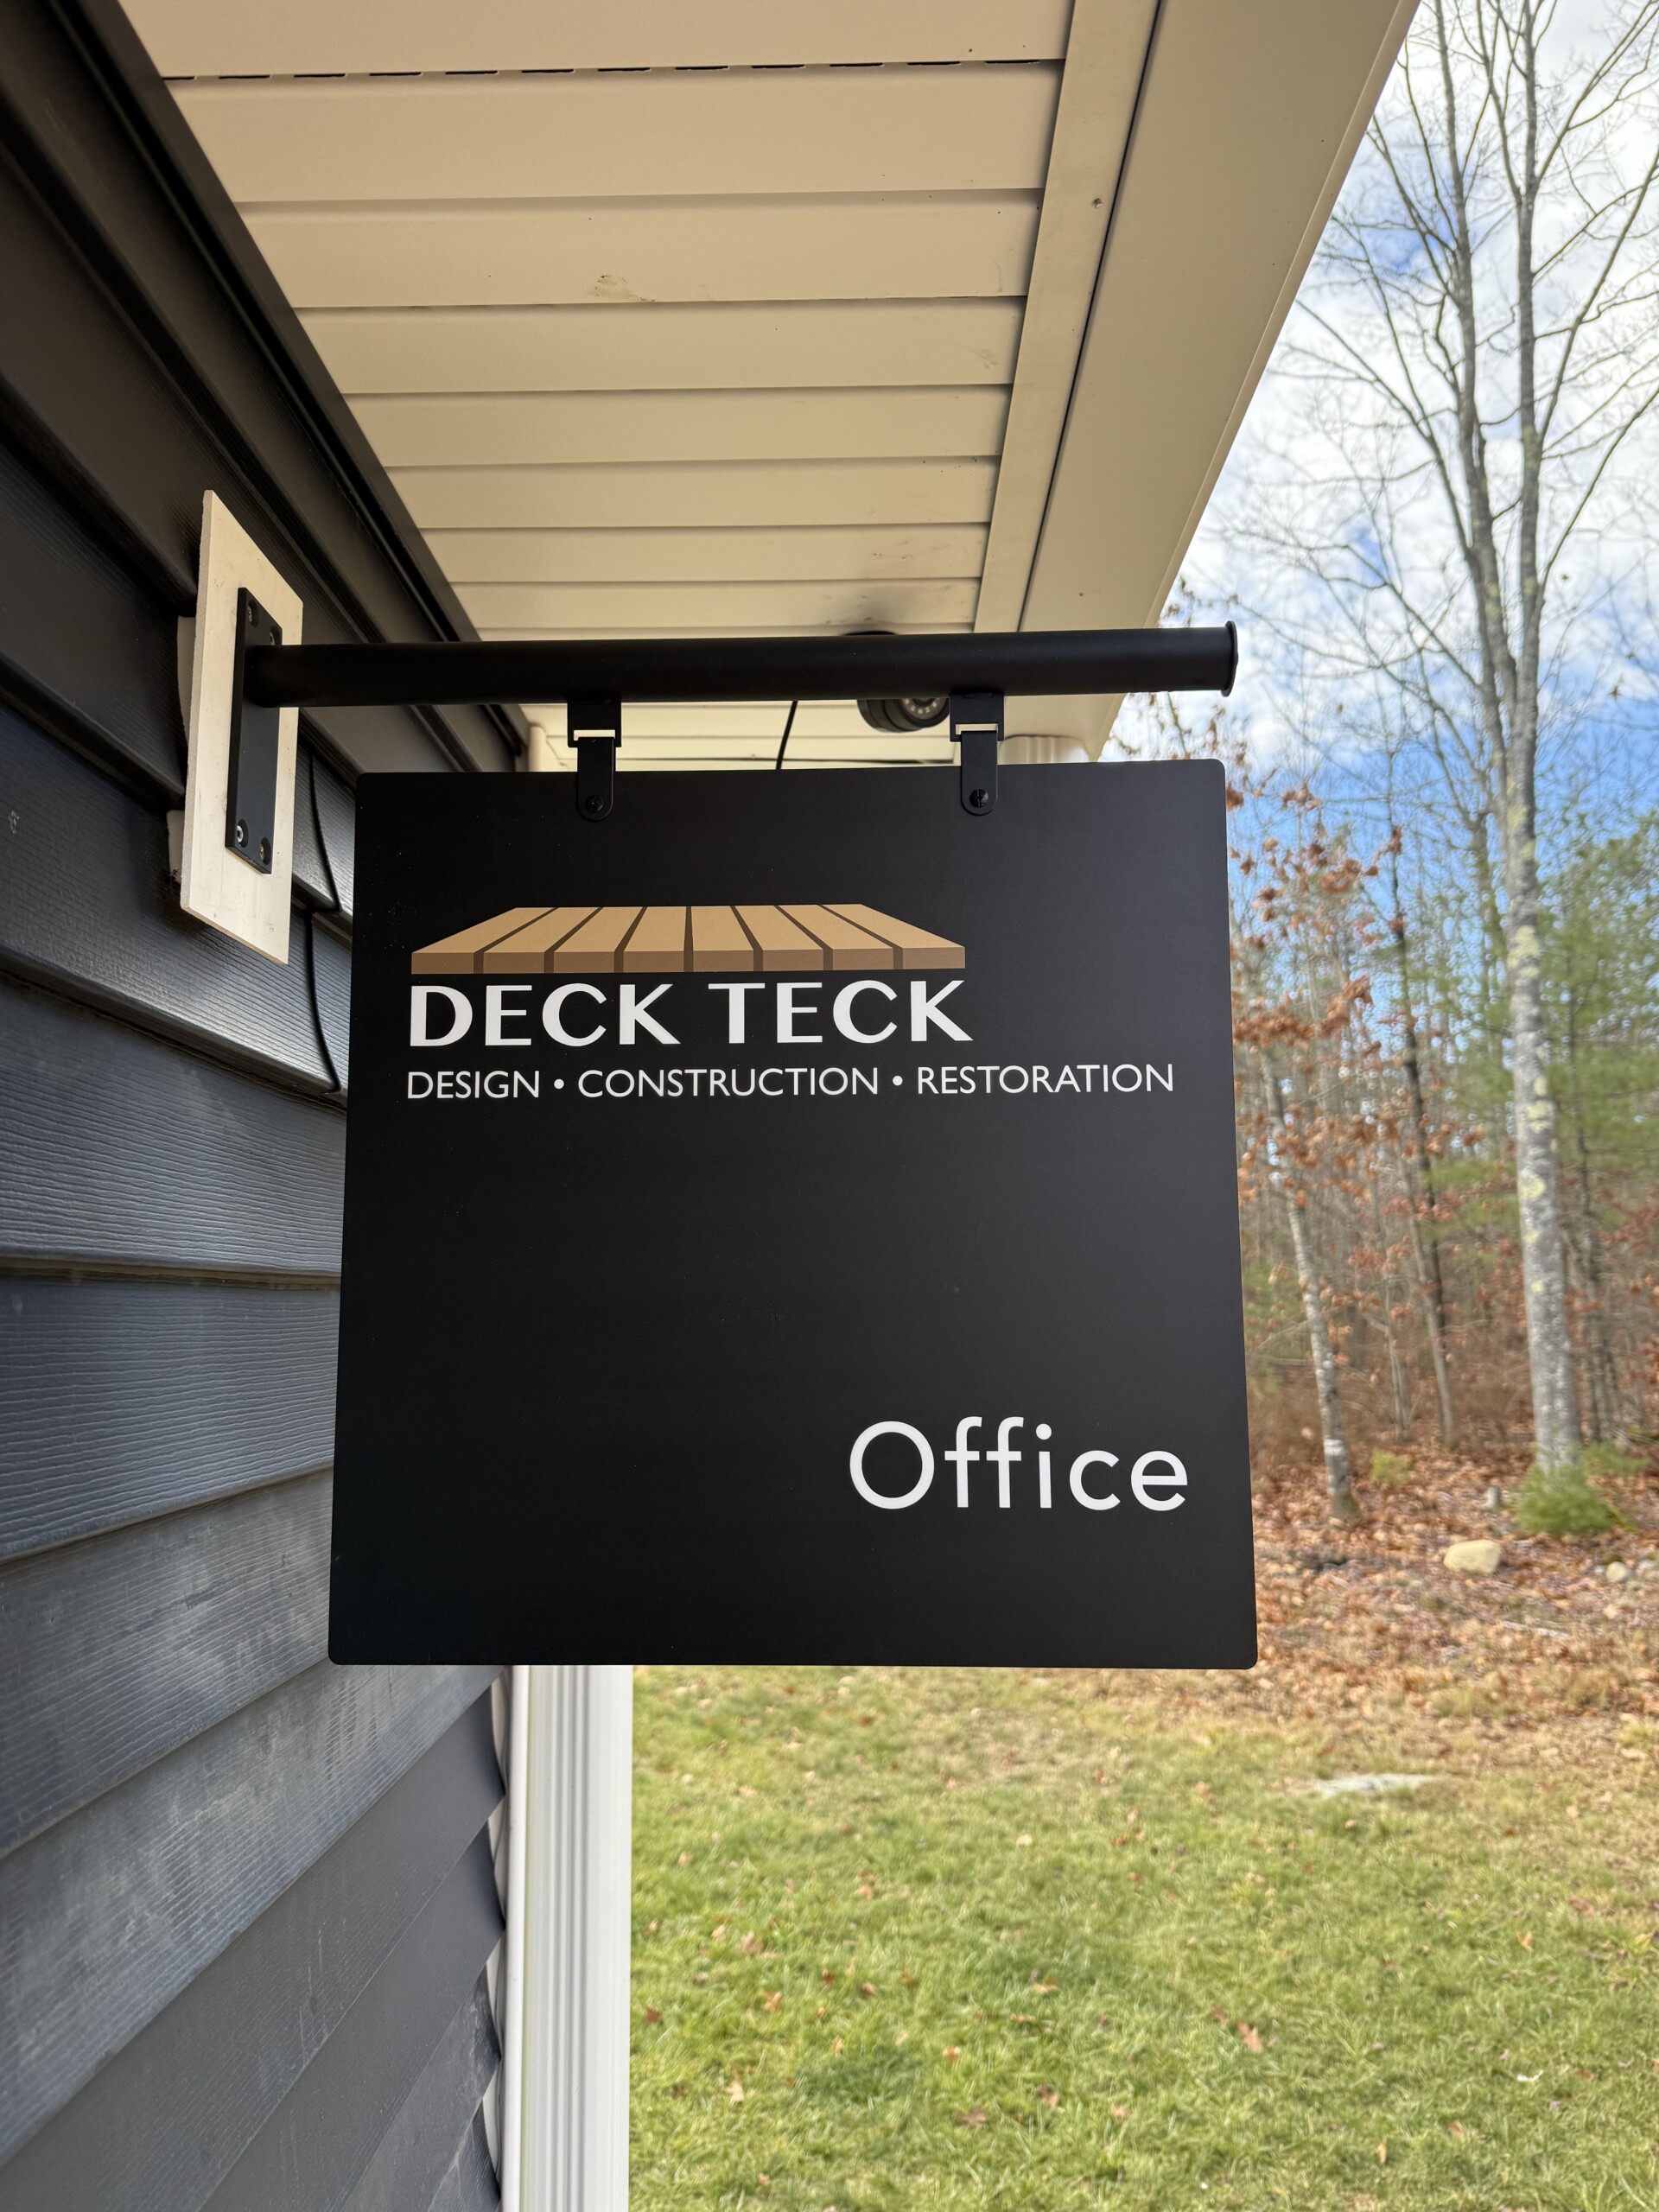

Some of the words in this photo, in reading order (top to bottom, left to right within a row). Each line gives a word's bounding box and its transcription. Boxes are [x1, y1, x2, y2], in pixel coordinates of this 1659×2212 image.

[410, 983, 681, 1047] DECK
[708, 980, 974, 1044] TECK
[407, 1070, 540, 1099] DESIGN
[577, 1067, 878, 1098] CONSTRUCTION
[918, 1063, 1173, 1095] RESTORATION
[849, 1415, 1188, 1512] Office
